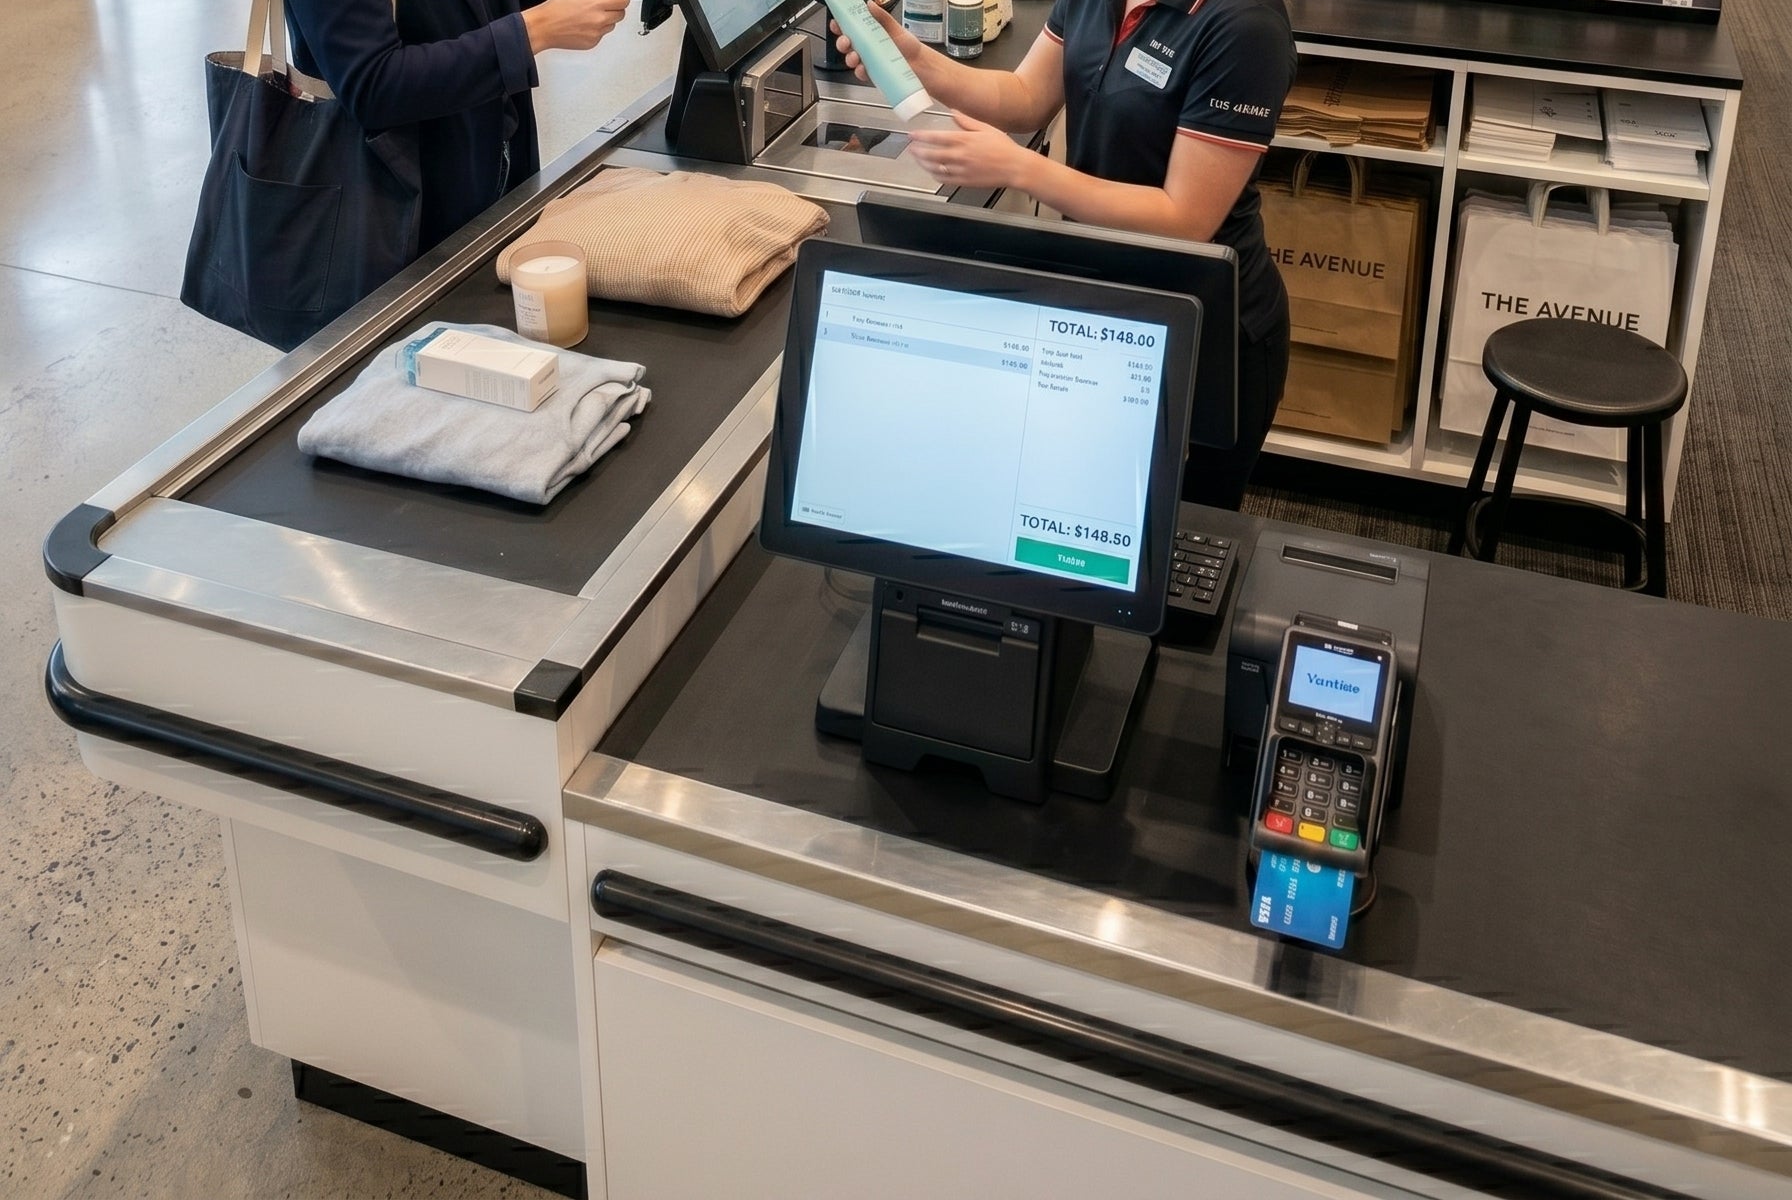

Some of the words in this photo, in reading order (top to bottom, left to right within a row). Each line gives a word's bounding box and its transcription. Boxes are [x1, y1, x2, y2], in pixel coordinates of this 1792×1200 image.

[1268, 247, 1294, 265] HE
[1299, 252, 1386, 280] AVENUE
[1481, 291, 1530, 315] THE
[1536, 301, 1640, 332] AVENUE
[1049, 319, 1098, 340] TOTAL:
[1100, 327, 1156, 349] $148.00
[1020, 513, 1071, 536] TOTAL:
[1074, 524, 1131, 548] $148.50
